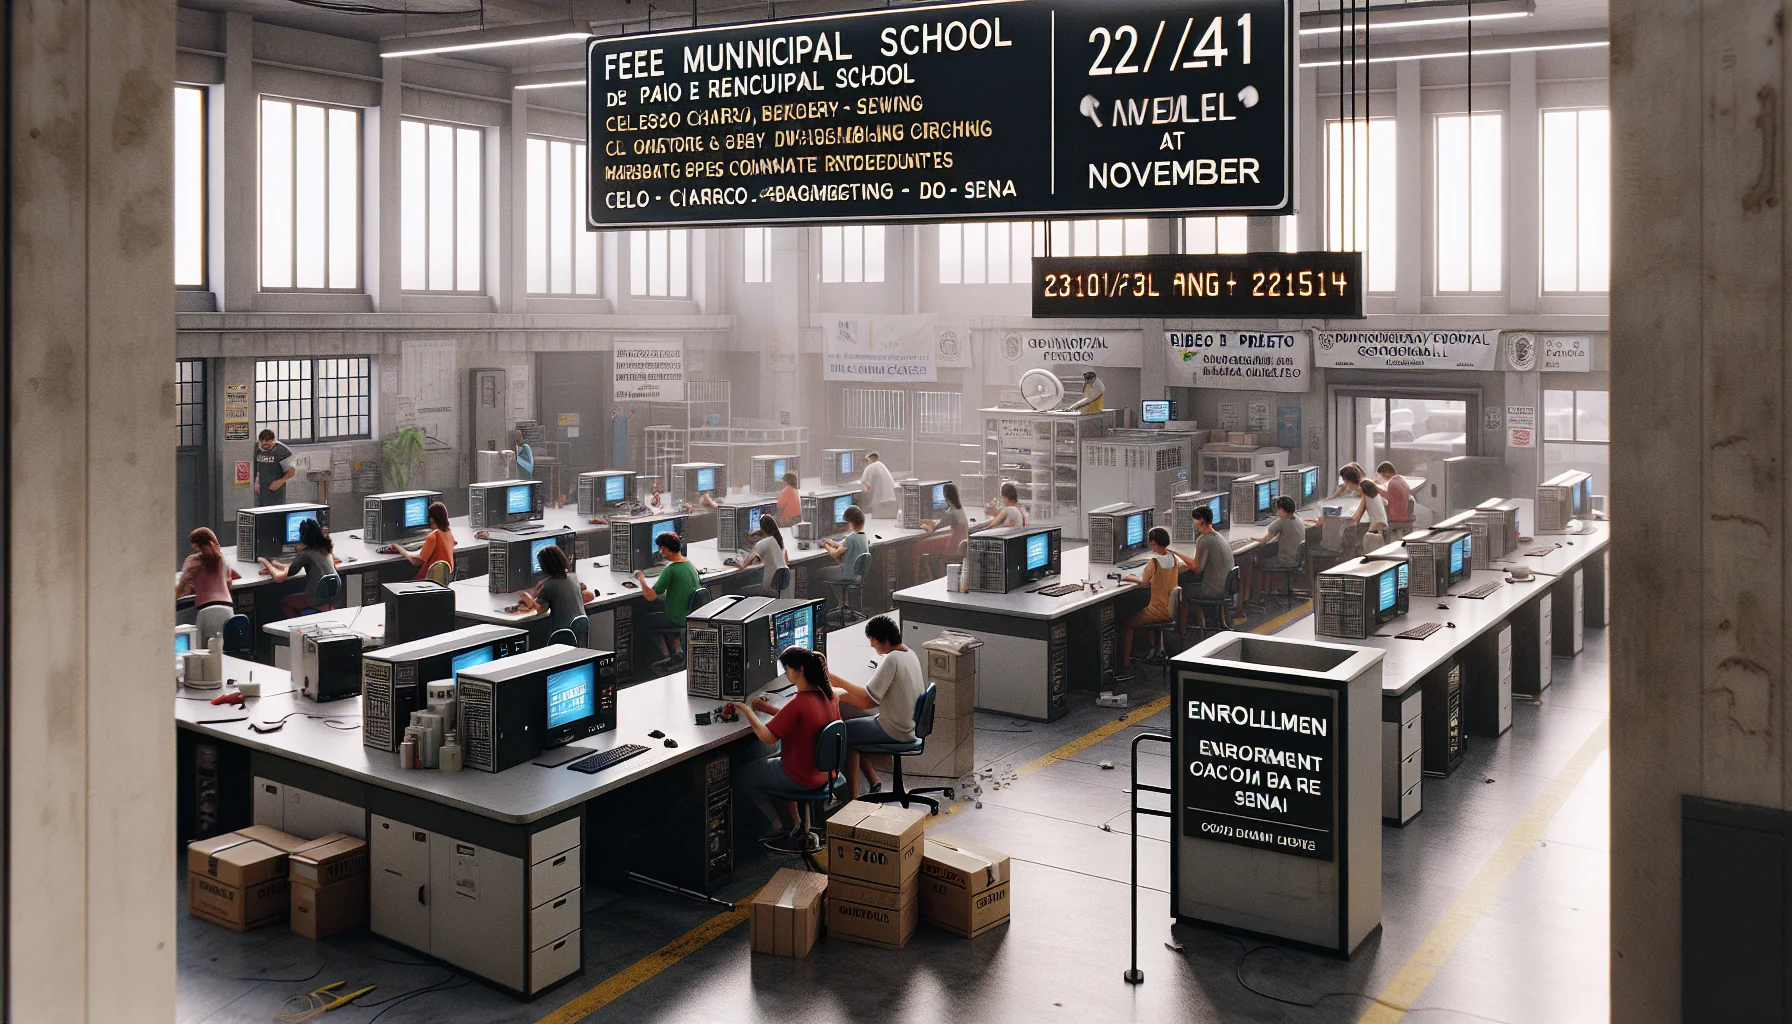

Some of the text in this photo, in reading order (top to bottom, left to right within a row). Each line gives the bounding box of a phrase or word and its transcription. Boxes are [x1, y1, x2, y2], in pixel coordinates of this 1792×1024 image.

[605, 17, 1012, 80] FEEE MUNNICIPAL SCHOOL
[690, 81, 699, 100] E
[708, 70, 824, 98] RENCUIPAL
[856, 95, 923, 115] SEWING
[1159, 131, 1186, 151] AT
[1088, 157, 1260, 190] NOVEMBER
[605, 190, 650, 209] CELO
[919, 181, 946, 200] DO
[964, 180, 1017, 199] SENA
[1174, 272, 1219, 297] ANG
[1252, 271, 1347, 297] 221514
